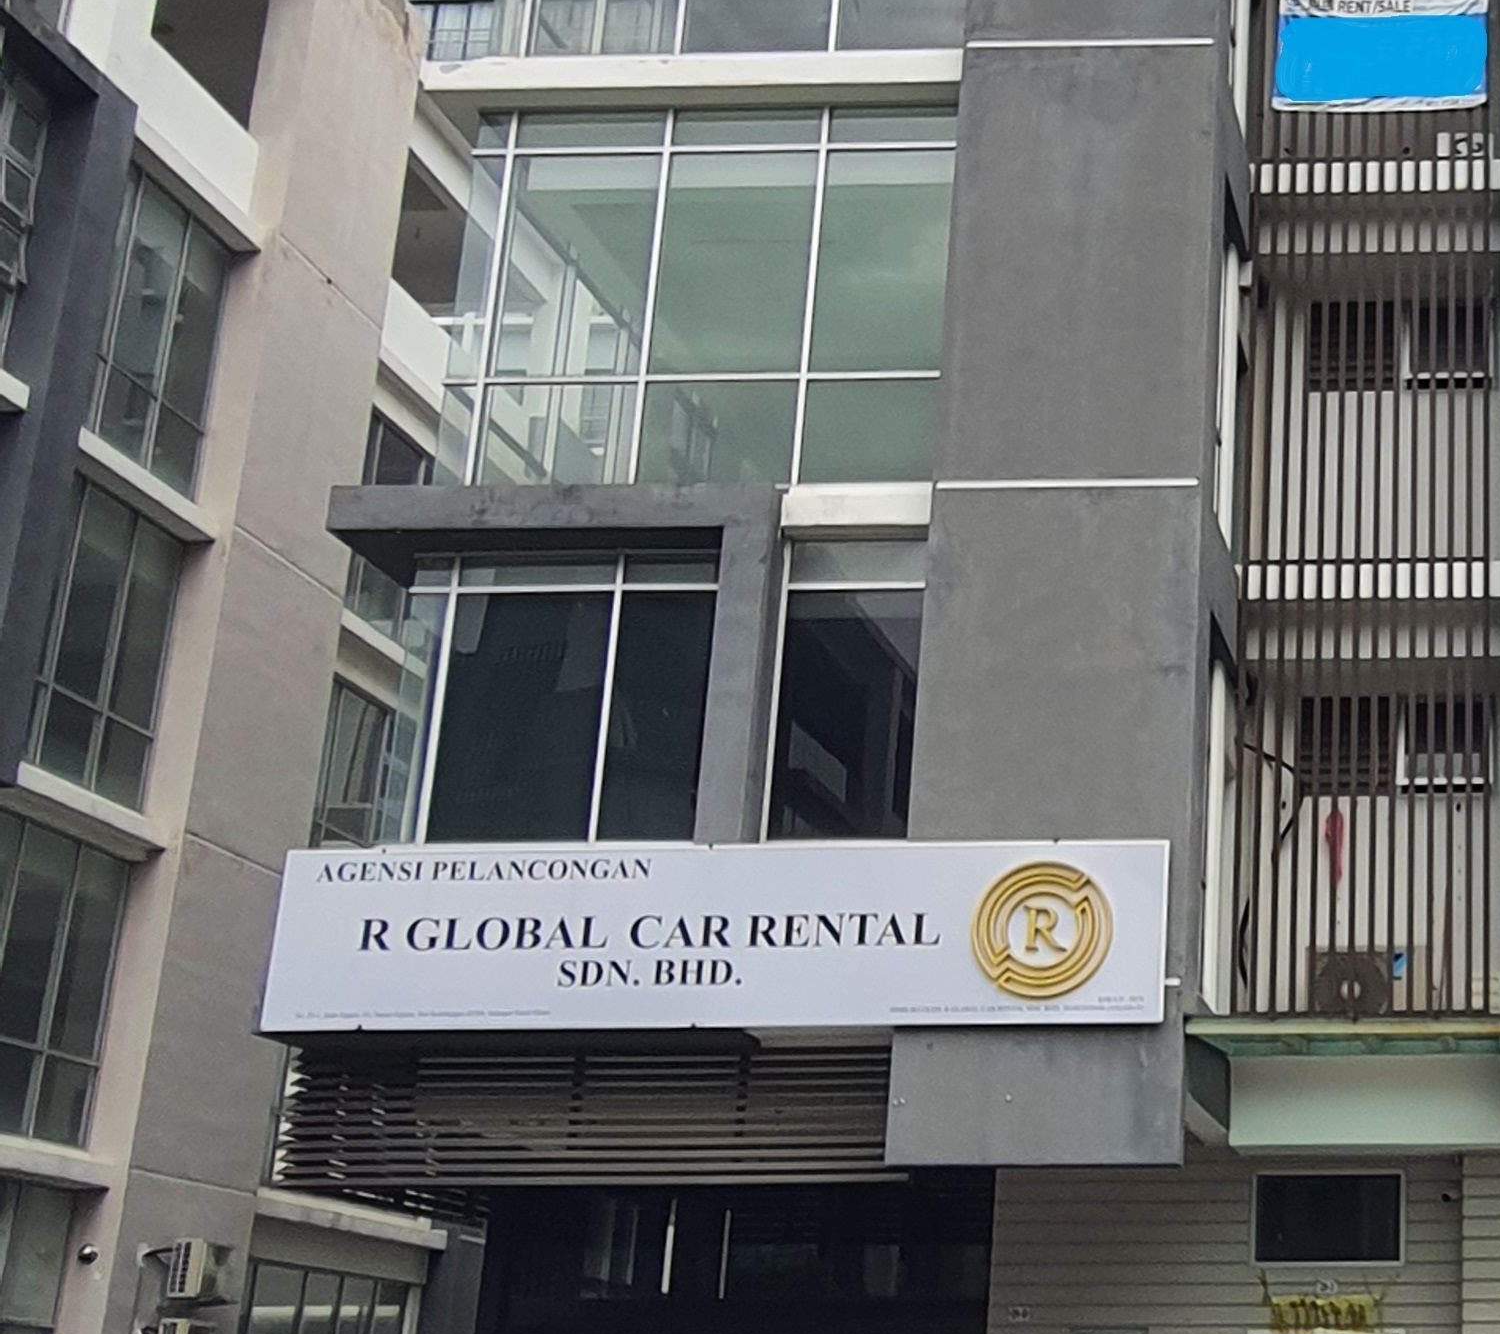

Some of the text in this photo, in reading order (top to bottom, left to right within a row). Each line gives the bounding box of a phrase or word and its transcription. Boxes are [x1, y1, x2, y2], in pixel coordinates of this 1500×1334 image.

[316, 858, 652, 883] AGENSI PELANCONGAN
[357, 913, 941, 951] R GLOBAL CAR RENTAL
[1023, 905, 1067, 953] R
[557, 958, 743, 987] SDN. BHD.
